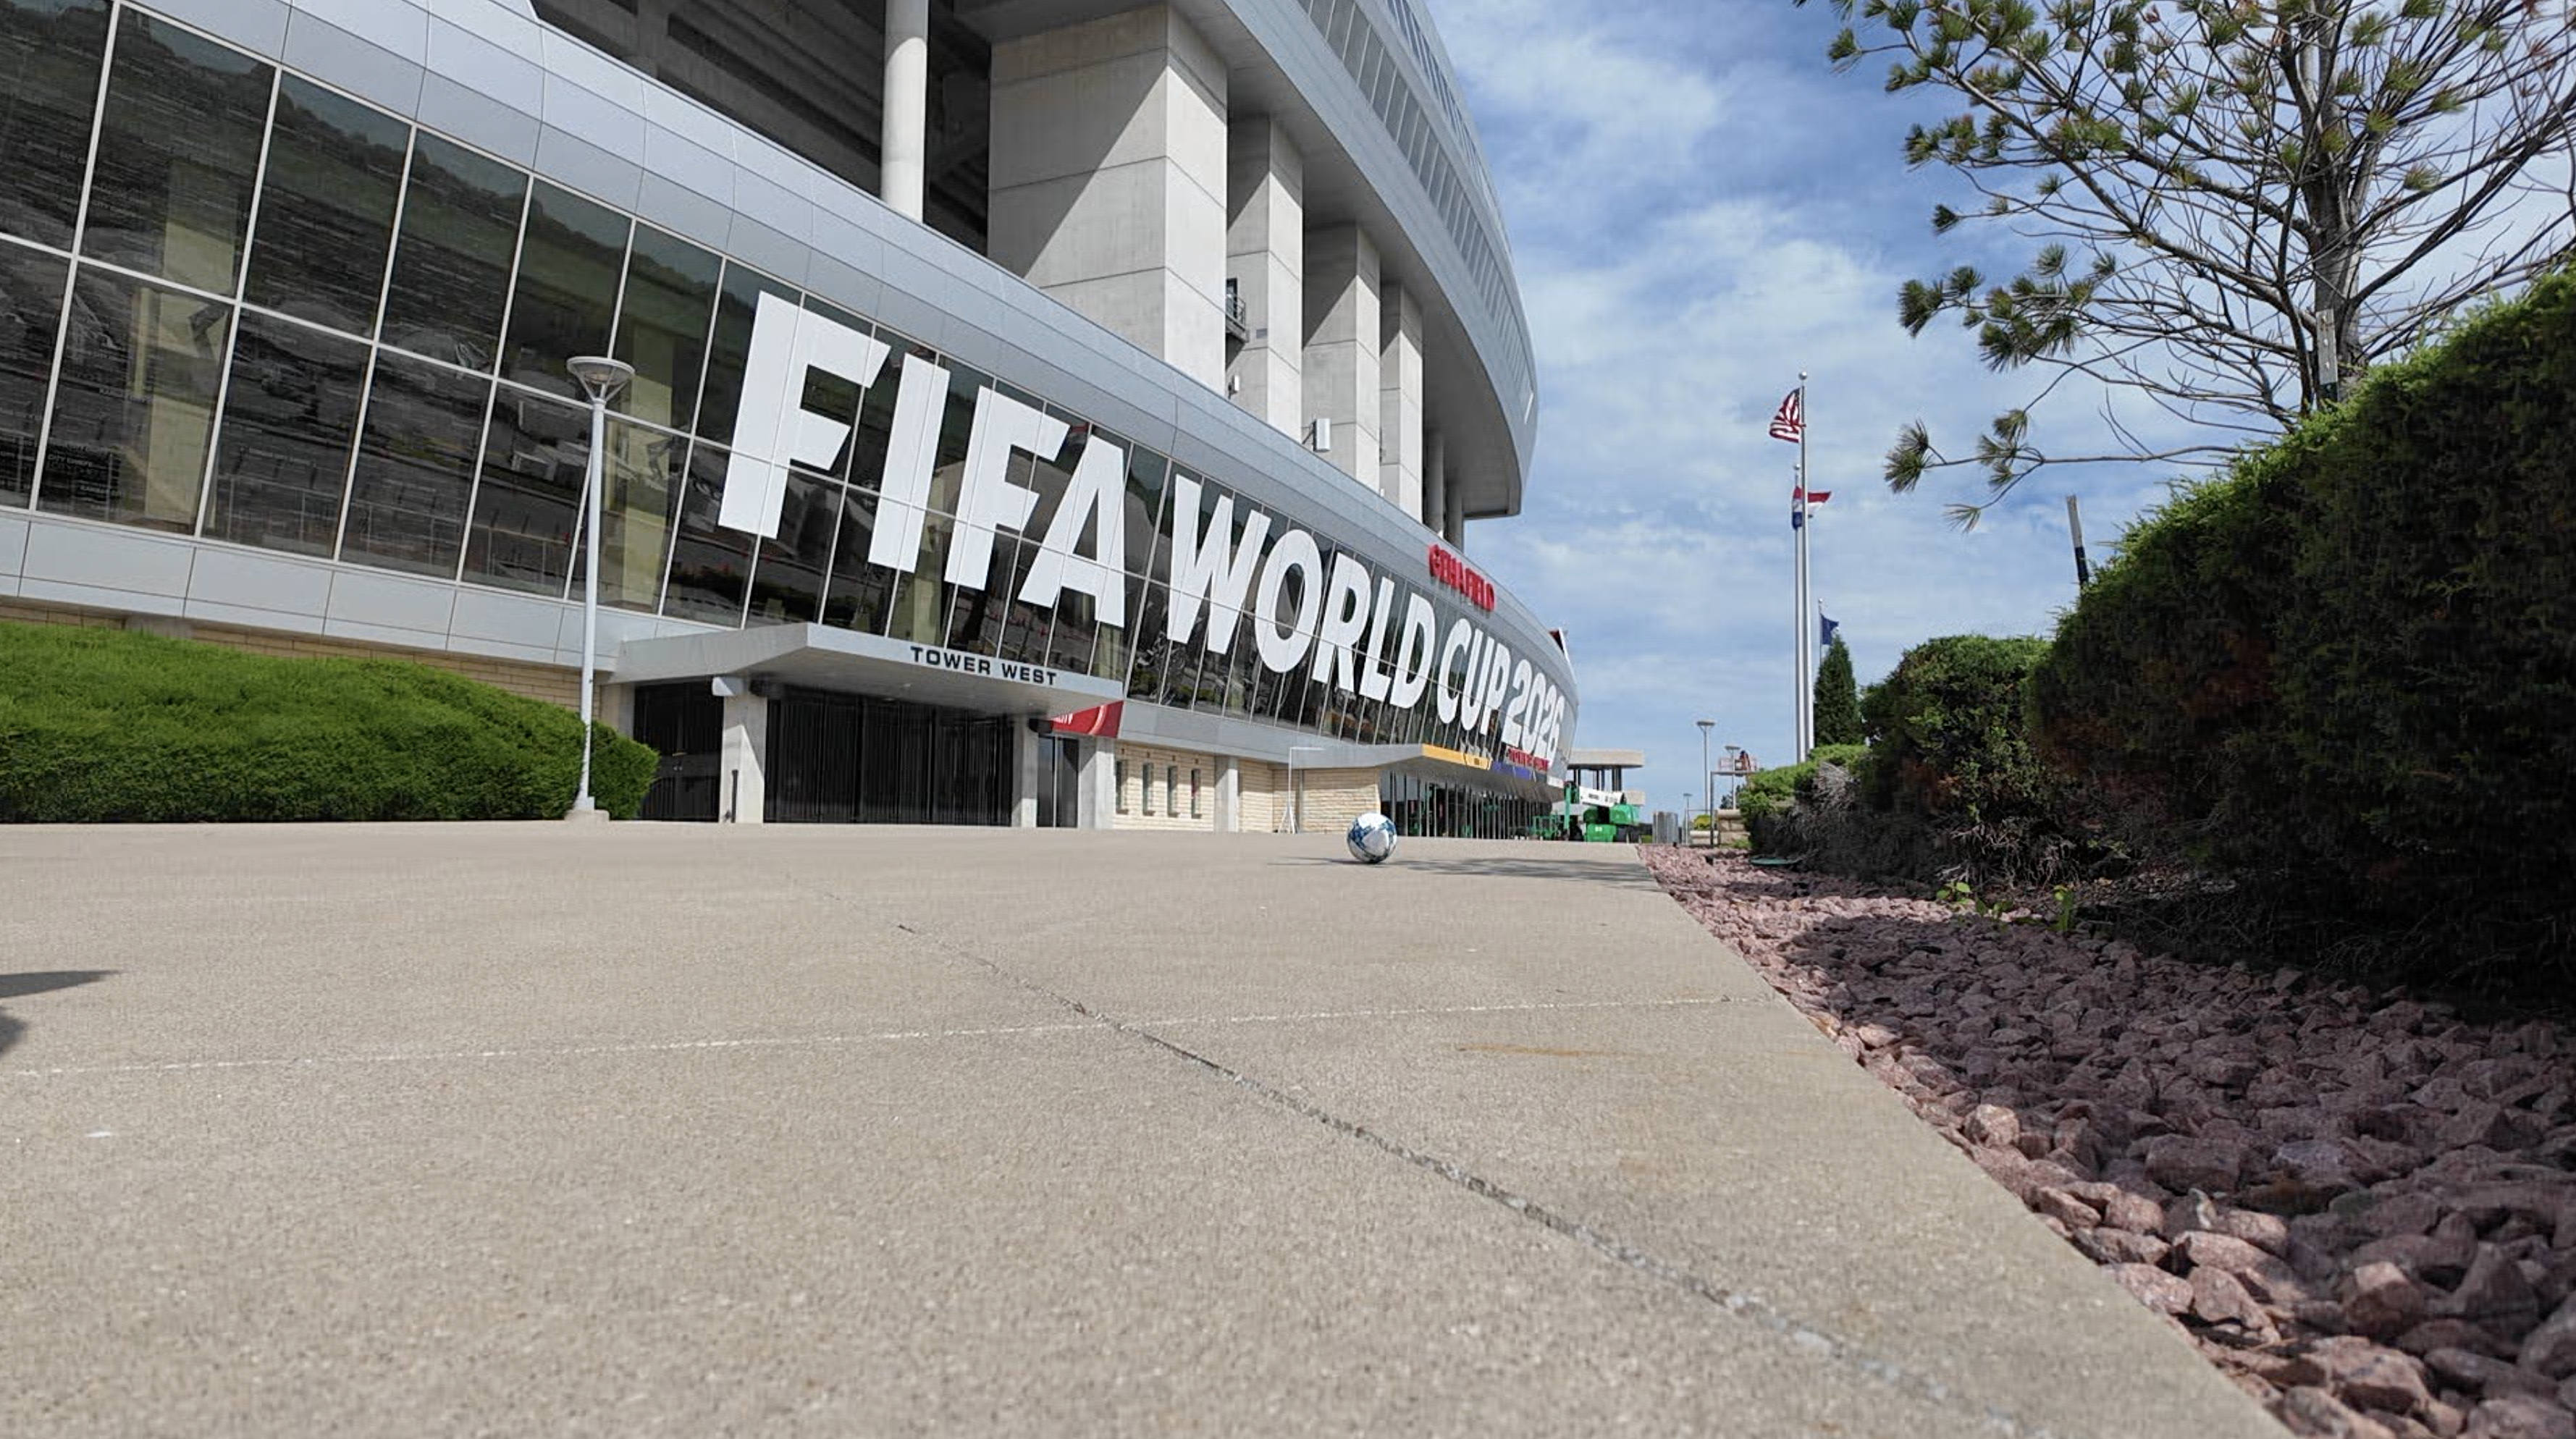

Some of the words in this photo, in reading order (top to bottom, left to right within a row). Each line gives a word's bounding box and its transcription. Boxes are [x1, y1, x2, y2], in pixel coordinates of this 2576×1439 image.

[717, 290, 1125, 628] FIFA
[1166, 474, 1436, 709] WORLD
[1436, 617, 1512, 735] CUP
[1500, 659, 1565, 770] 2026
[910, 646, 991, 675] TOWER
[1001, 662, 1057, 686] WEST
